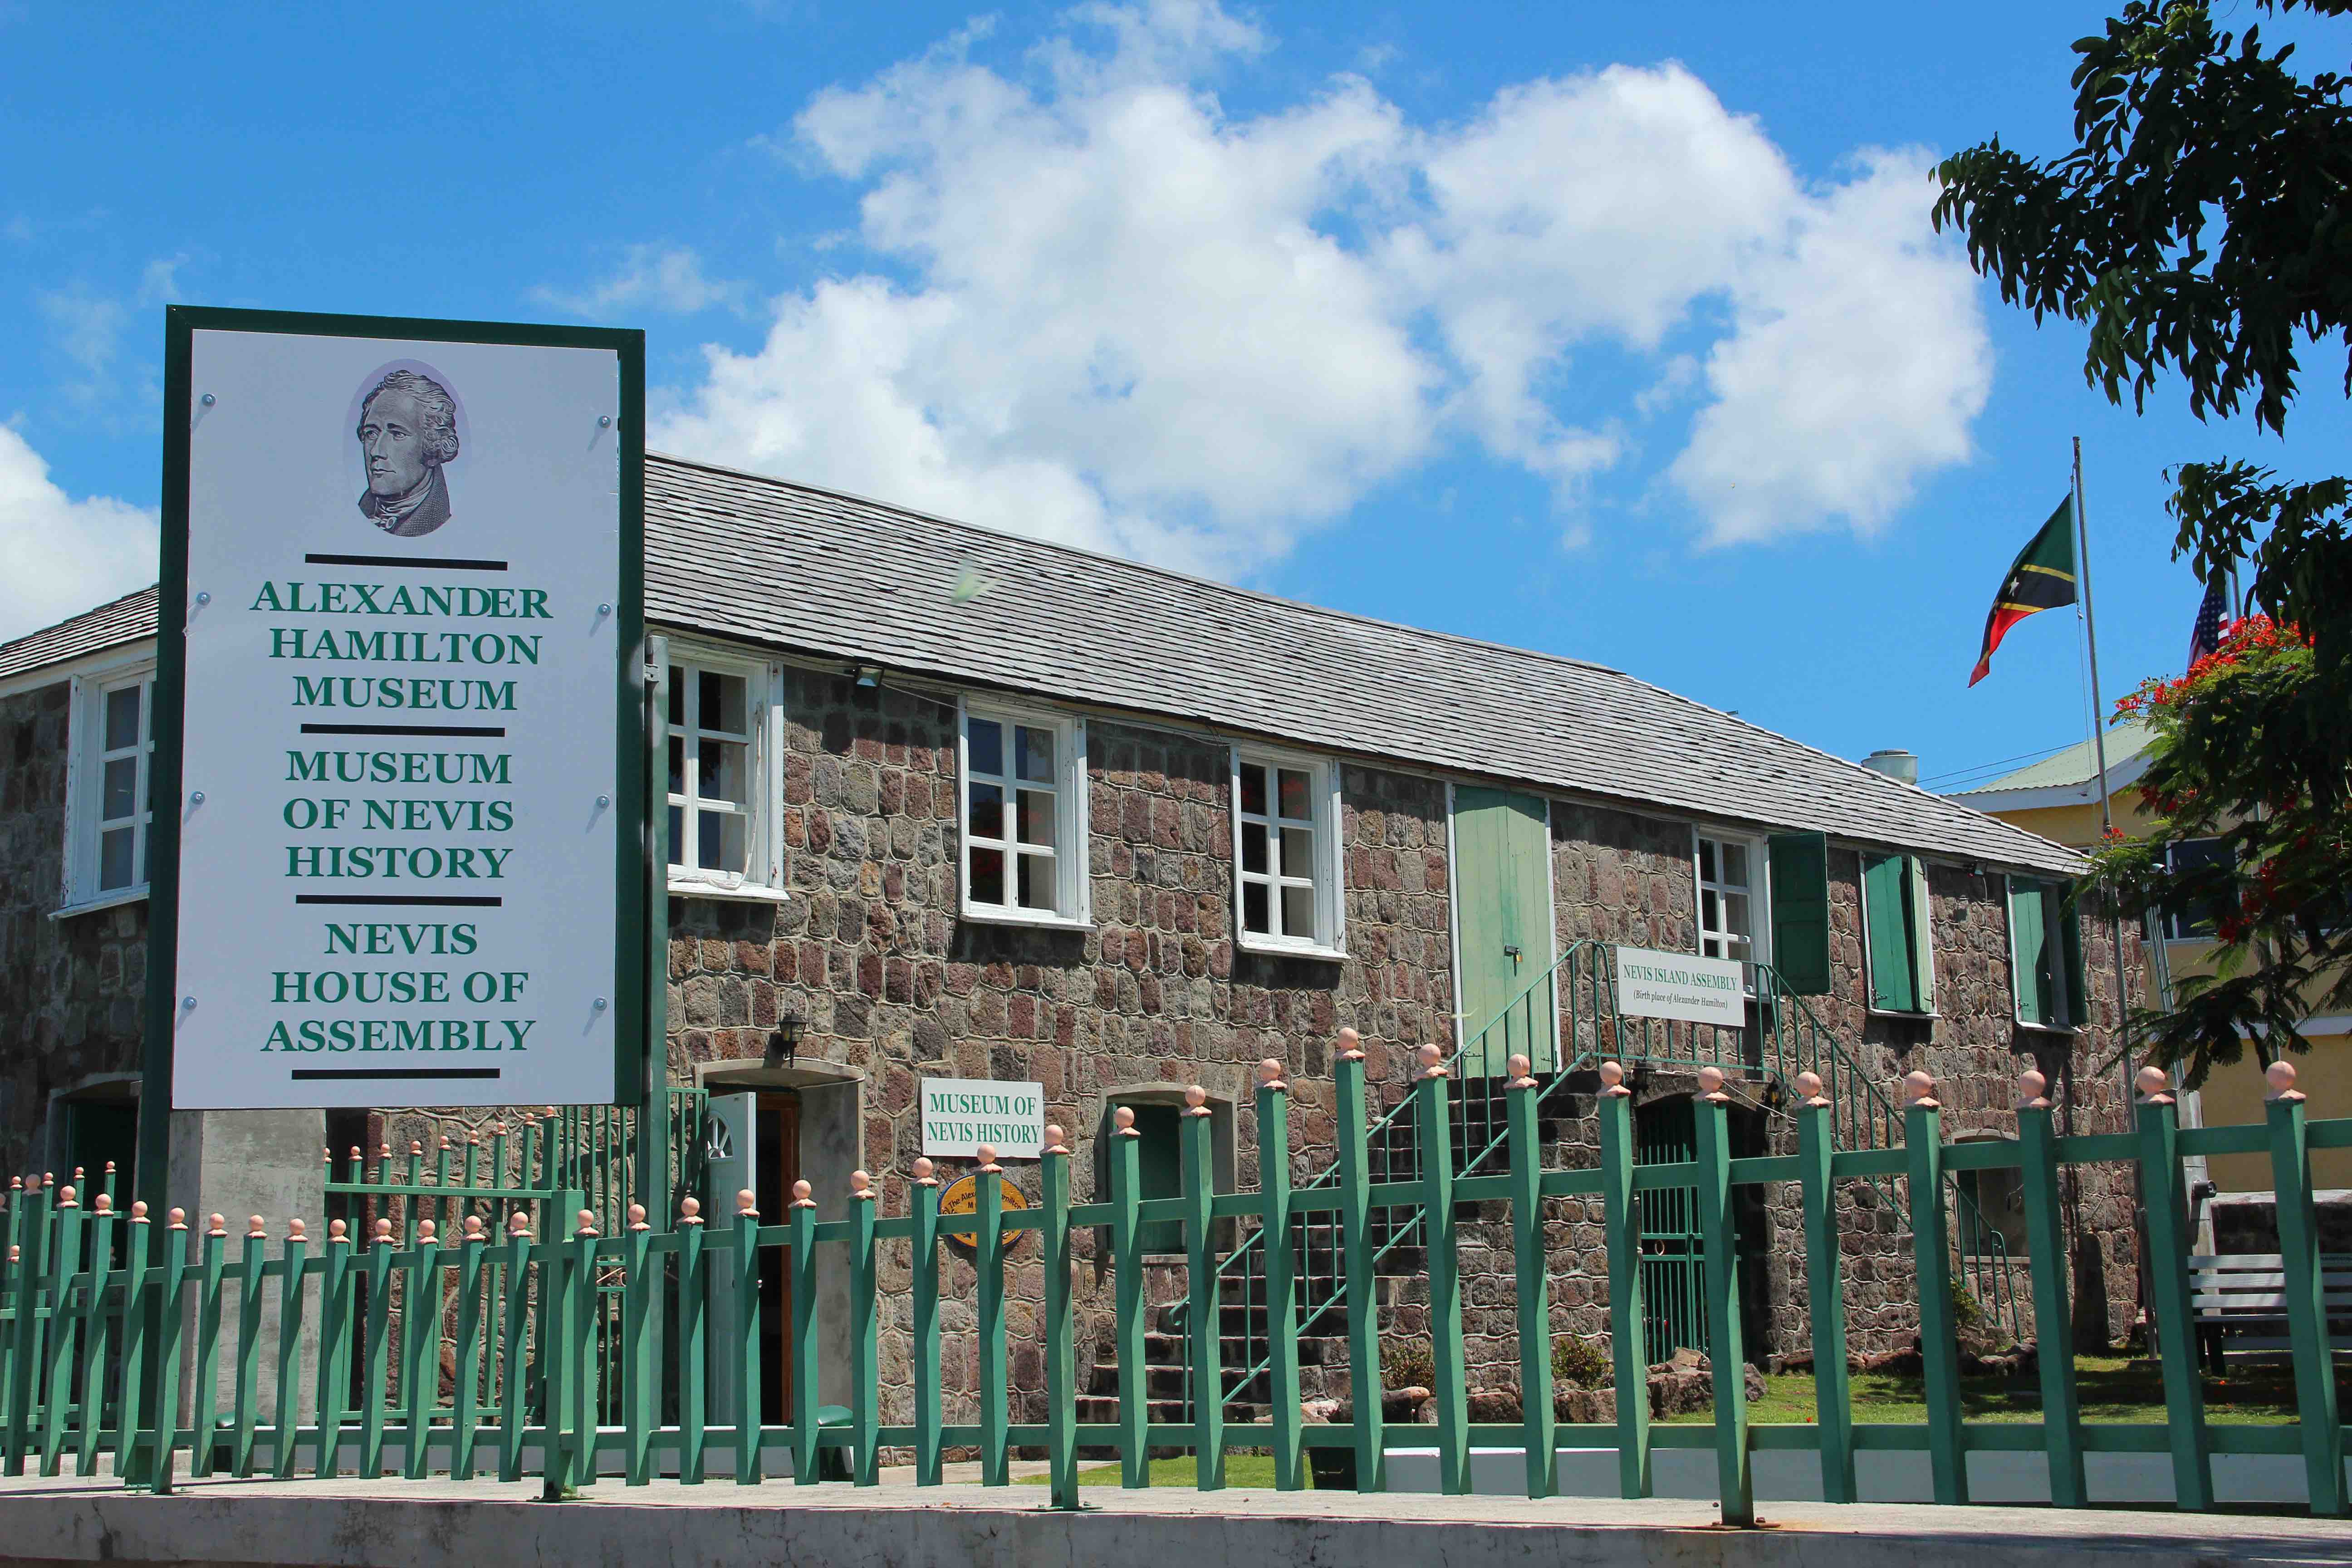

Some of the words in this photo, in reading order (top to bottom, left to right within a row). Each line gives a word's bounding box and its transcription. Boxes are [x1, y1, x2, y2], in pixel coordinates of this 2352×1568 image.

[249, 581, 554, 619] ALEXANDER
[269, 628, 543, 665] HAMILTON
[291, 676, 518, 711] MUSEUM
[285, 751, 512, 784] MUSEUM
[283, 798, 350, 829] OF
[362, 799, 514, 832] NEVIS
[284, 846, 514, 879] HISTORY
[323, 923, 477, 955] NEVIS
[271, 971, 450, 1003] HOUSE
[463, 971, 529, 1003] OF
[1623, 964, 1652, 981] NEVIS
[1655, 968, 1688, 985] ISLAND
[1690, 972, 1737, 990] ASSEMBLY
[1633, 990, 1650, 1000] (Birth
[1651, 991, 1666, 1003] place
[1666, 994, 1673, 1004] of
[1673, 994, 1700, 1005] Alexander
[1701, 997, 1728, 1009] Hamilton)
[260, 1020, 536, 1052] ASSEMBLY
[930, 1093, 1009, 1115] MUSEUM
[1014, 1096, 1036, 1116] OF
[927, 1122, 973, 1142] NEVIS
[977, 1123, 1040, 1144] HISTORY
[948, 1198, 960, 1208] The
